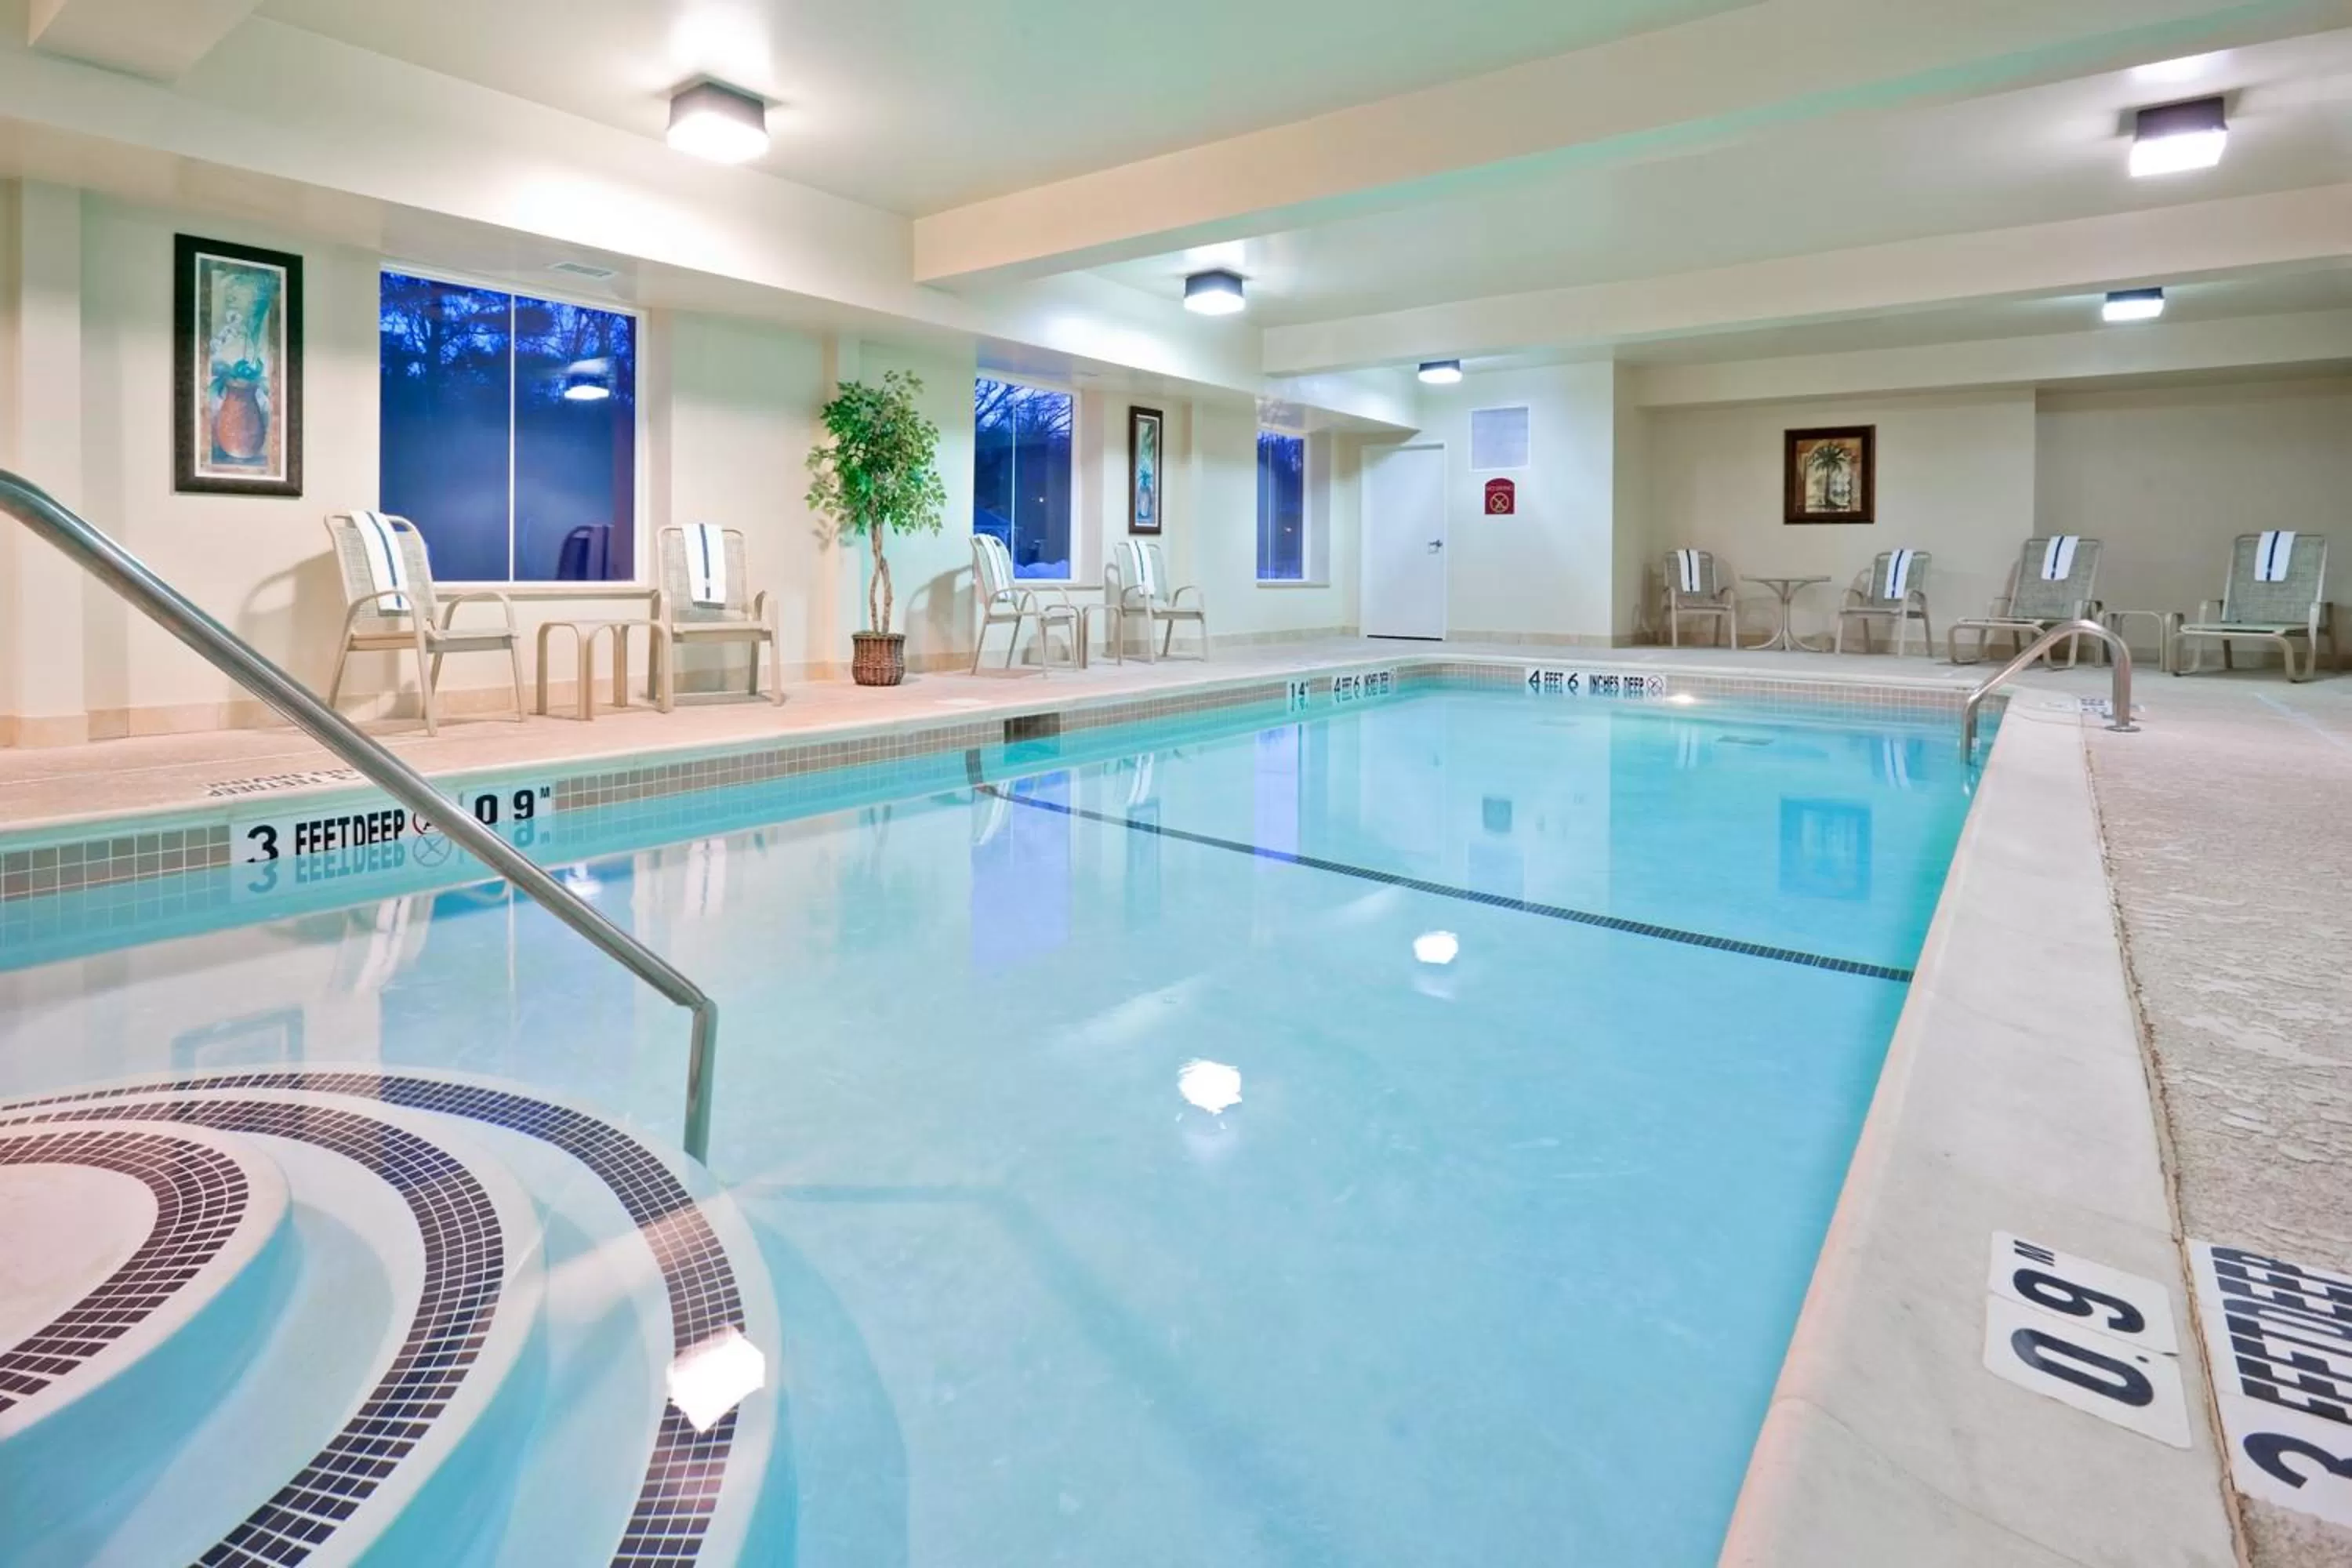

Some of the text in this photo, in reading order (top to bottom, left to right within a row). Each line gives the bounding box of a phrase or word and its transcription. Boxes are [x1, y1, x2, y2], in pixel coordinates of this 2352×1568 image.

[1528, 670, 1541, 683] 4
[1567, 672, 1579, 688] 6
[247, 825, 279, 863] 3
